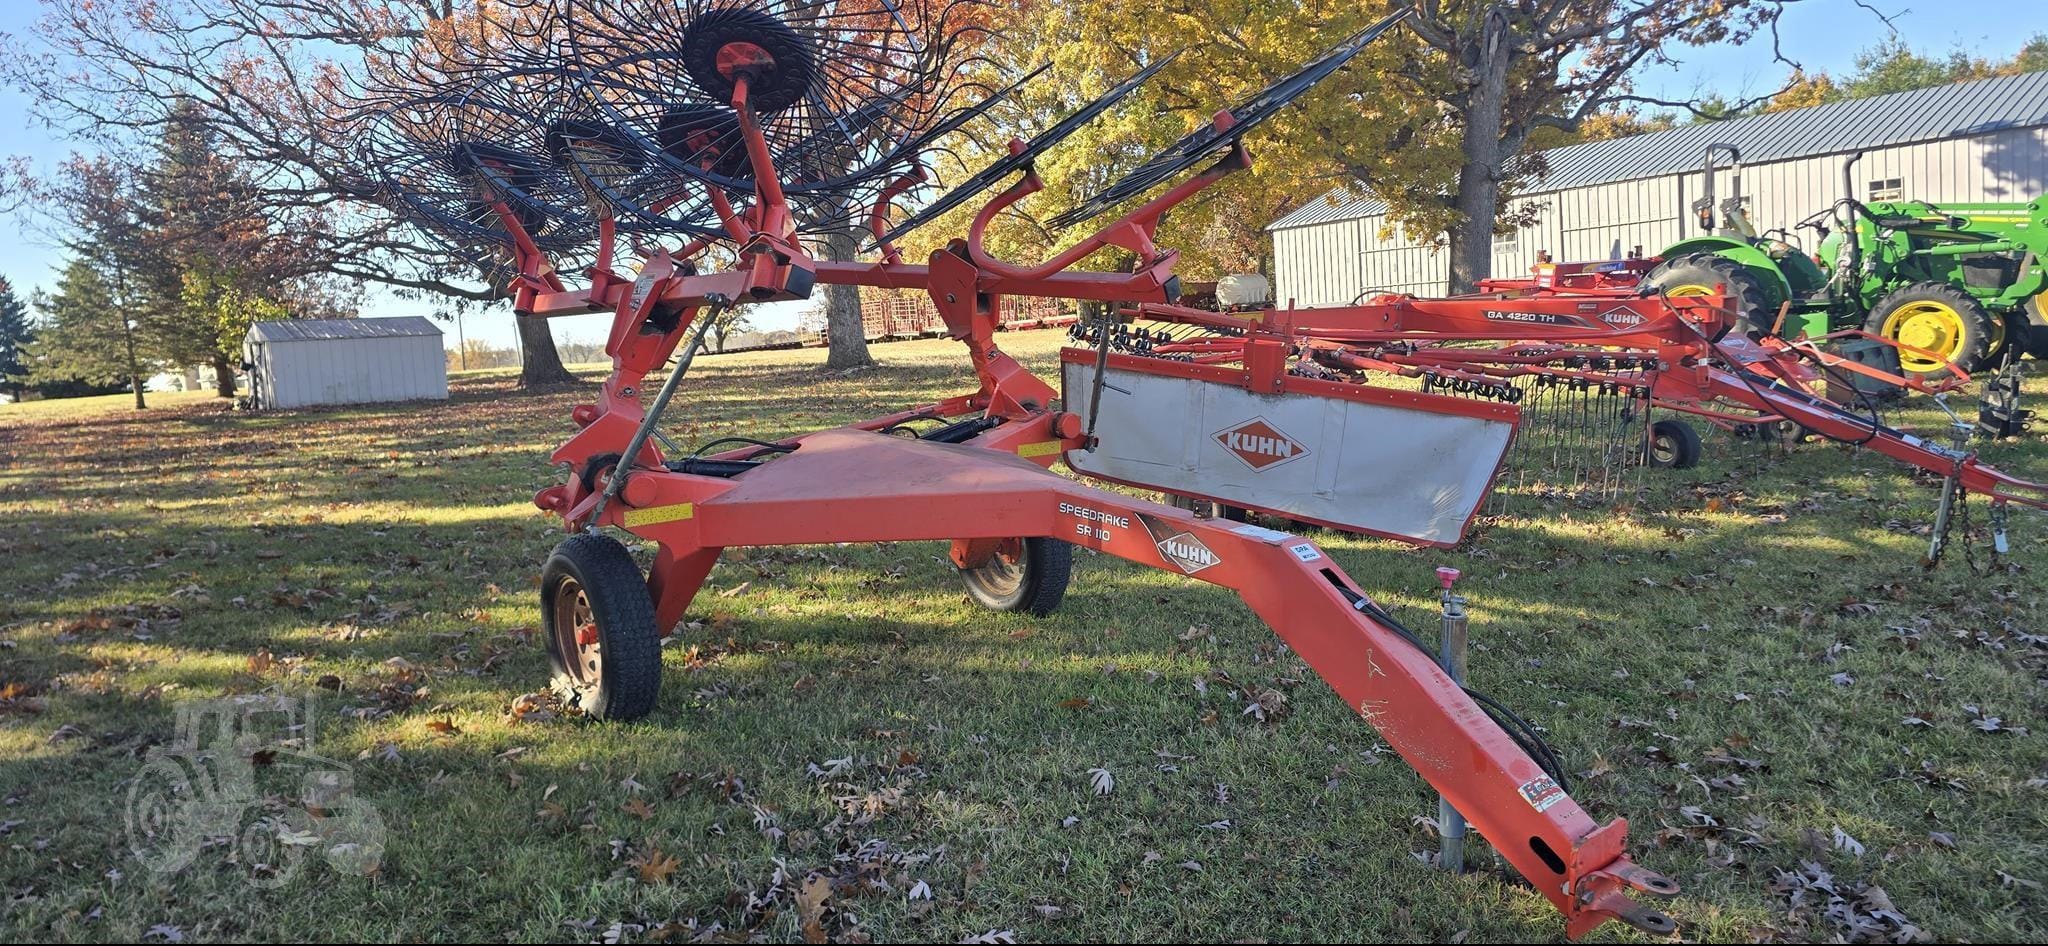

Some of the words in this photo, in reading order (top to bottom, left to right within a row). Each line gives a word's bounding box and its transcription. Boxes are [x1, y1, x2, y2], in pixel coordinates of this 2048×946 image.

[1487, 311, 1504, 319] GA
[1507, 312, 1536, 321] 4220
[1539, 314, 1556, 323] TH
[1605, 313, 1640, 324] KUHN
[1227, 431, 1292, 458] KUHN
[1059, 503, 1129, 529] SPEEDRAKE
[1076, 524, 1092, 537] SR
[1095, 528, 1110, 541] 110
[1167, 540, 1212, 565] KUHN
